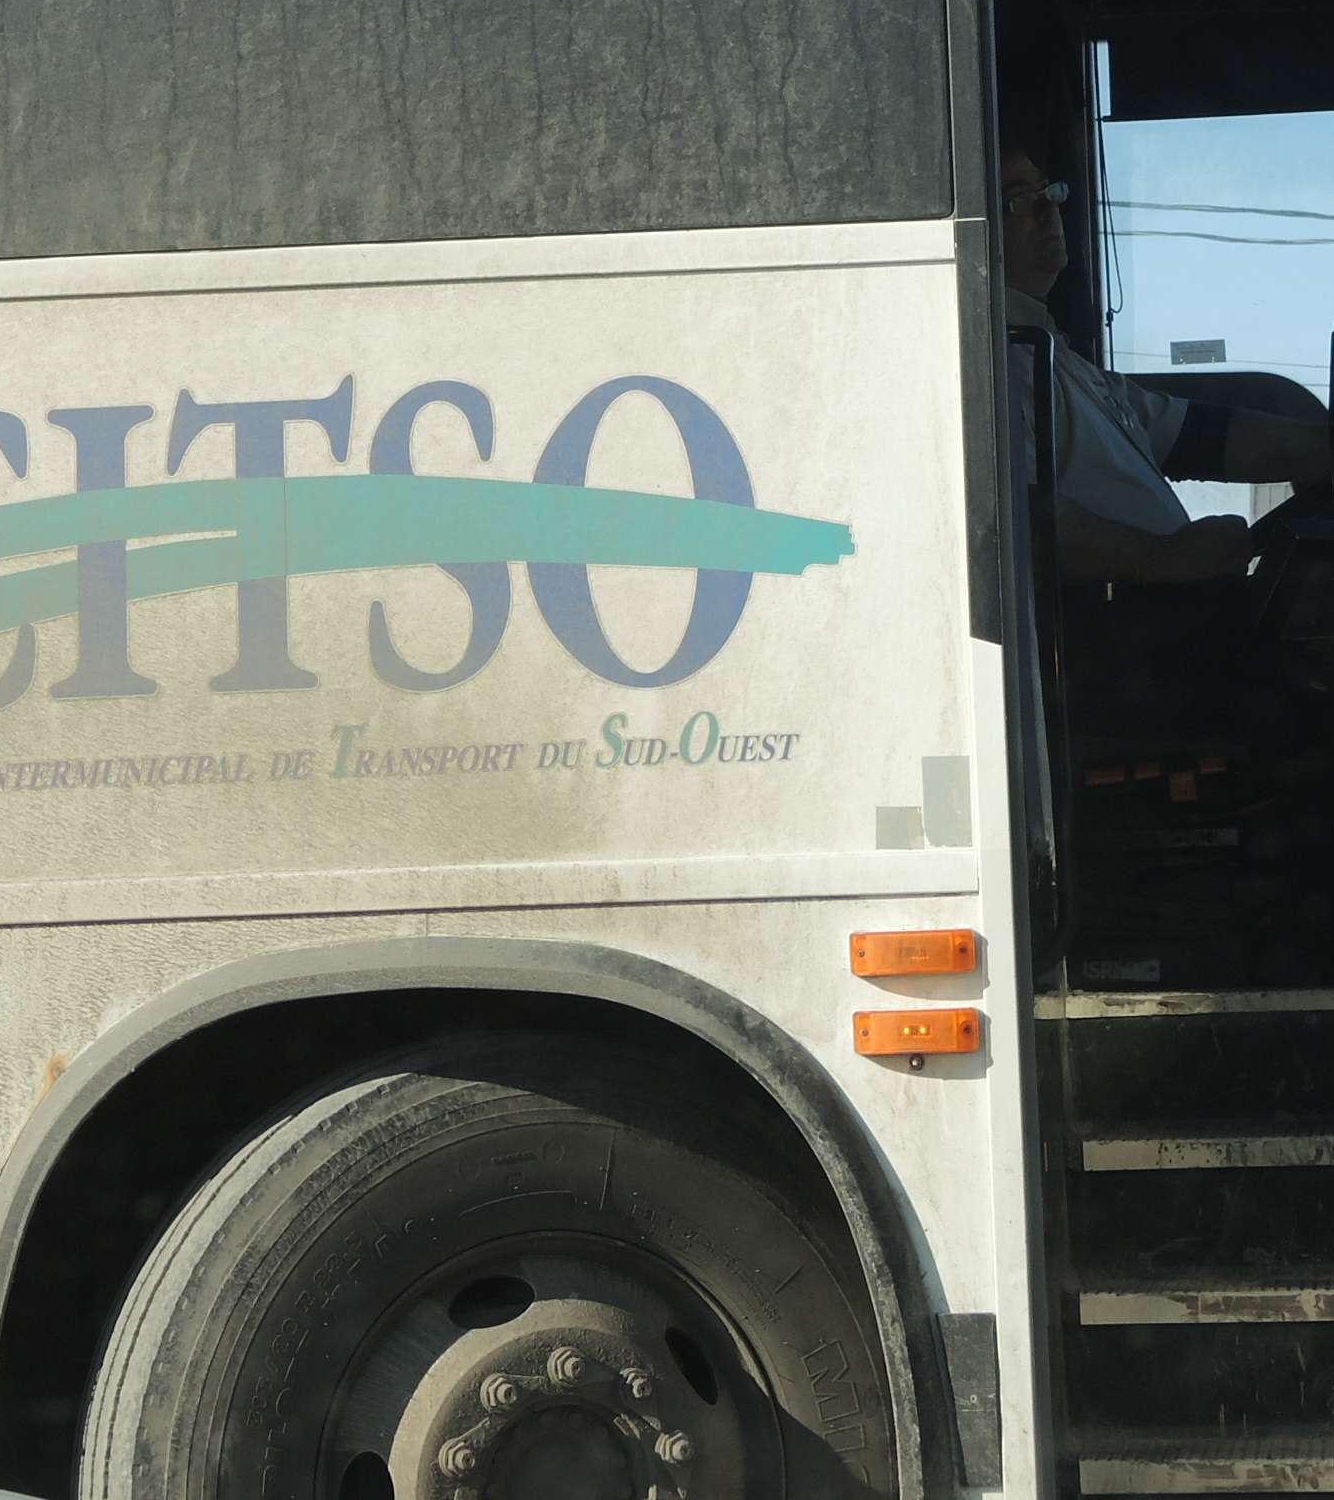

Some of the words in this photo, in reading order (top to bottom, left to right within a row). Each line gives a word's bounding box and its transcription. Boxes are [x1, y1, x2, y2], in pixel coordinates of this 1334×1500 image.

[269, 749, 316, 780] DE
[328, 722, 525, 780] TRANSPORT
[536, 738, 586, 770] DU
[595, 710, 799, 768] SUD-OUEST
